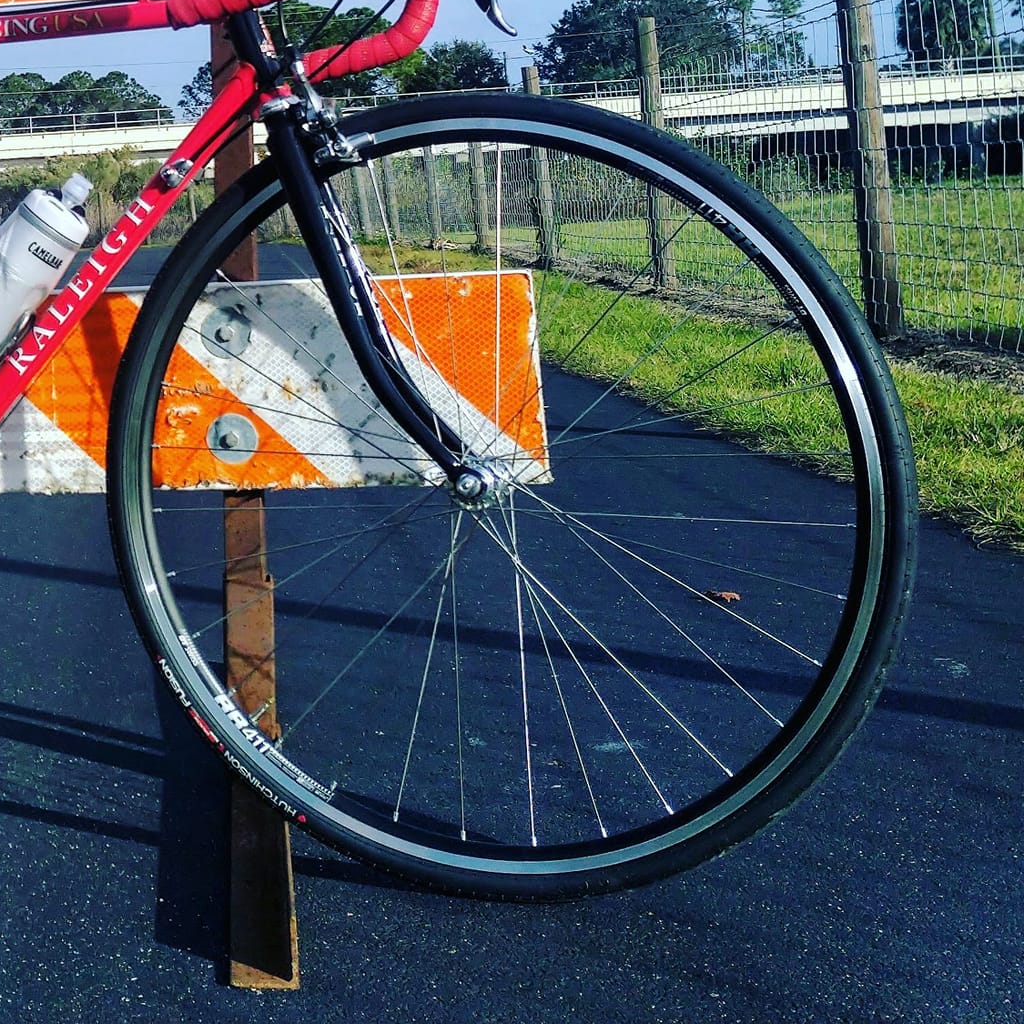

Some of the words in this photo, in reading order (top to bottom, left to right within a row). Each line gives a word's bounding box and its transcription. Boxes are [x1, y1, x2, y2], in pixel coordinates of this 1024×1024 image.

[53, 10, 105, 32] USA
[9, 196, 155, 376] RALEIGH
[158, 658, 192, 708] FUSION
[223, 750, 298, 818] HUTCHINSON
